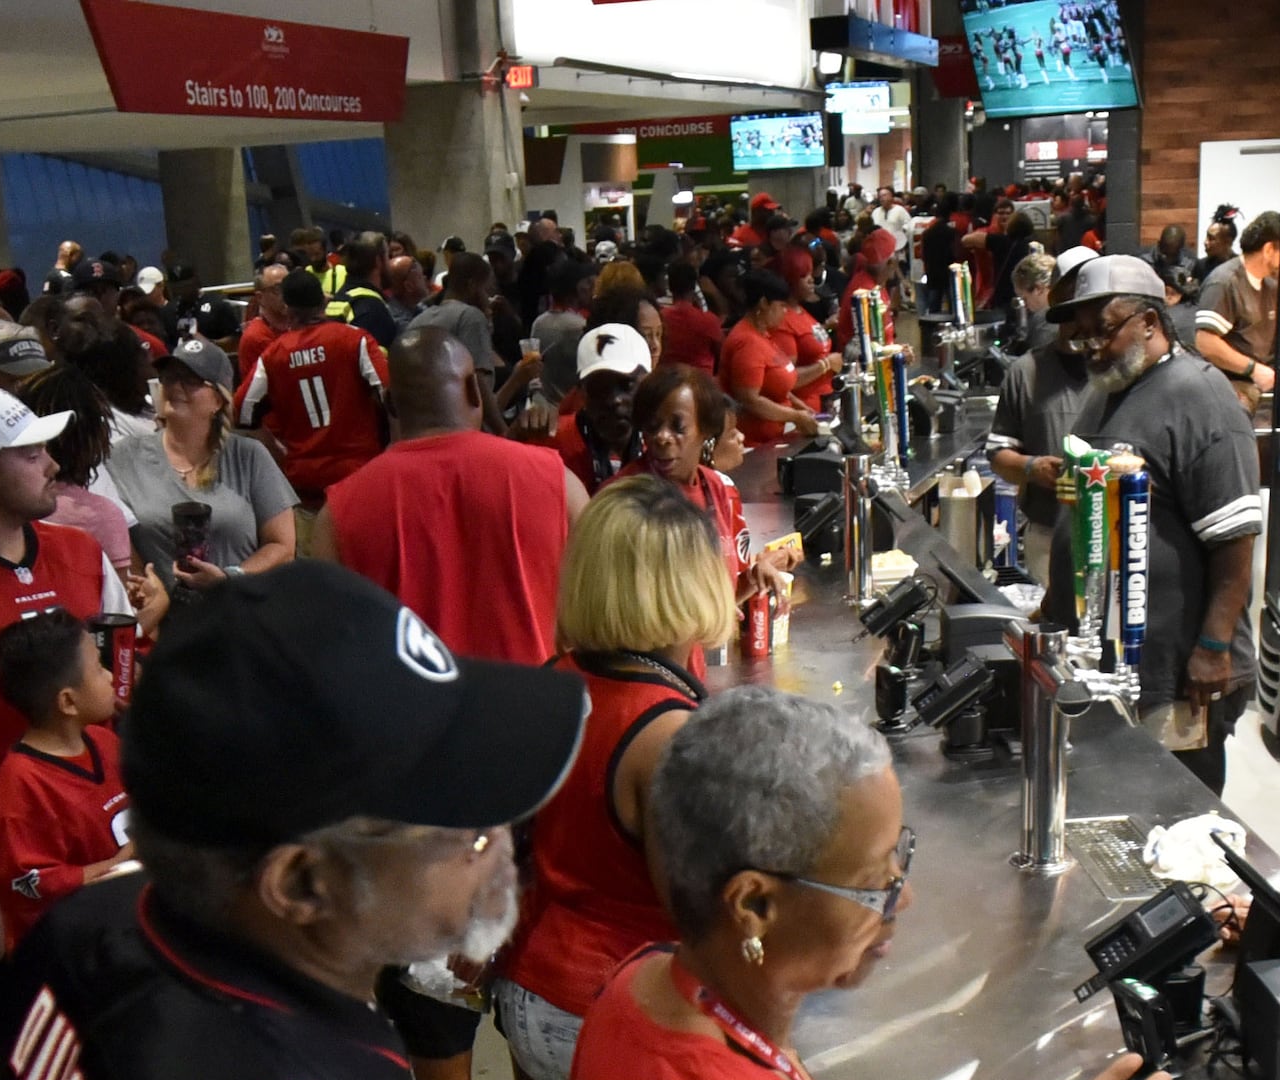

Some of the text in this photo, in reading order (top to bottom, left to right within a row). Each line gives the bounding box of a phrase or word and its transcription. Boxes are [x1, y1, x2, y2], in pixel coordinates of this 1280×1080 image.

[510, 66, 533, 87] EXIT
[185, 79, 363, 113] Stairs to 100, 200 Concourses
[640, 121, 714, 138] CONCOURSE
[289, 345, 326, 369] JONES
[299, 375, 330, 429] 11
[1088, 491, 1103, 564] Heineken
[1127, 499, 1148, 625] BUD LIGHT
[15, 590, 56, 604] FALCONS
